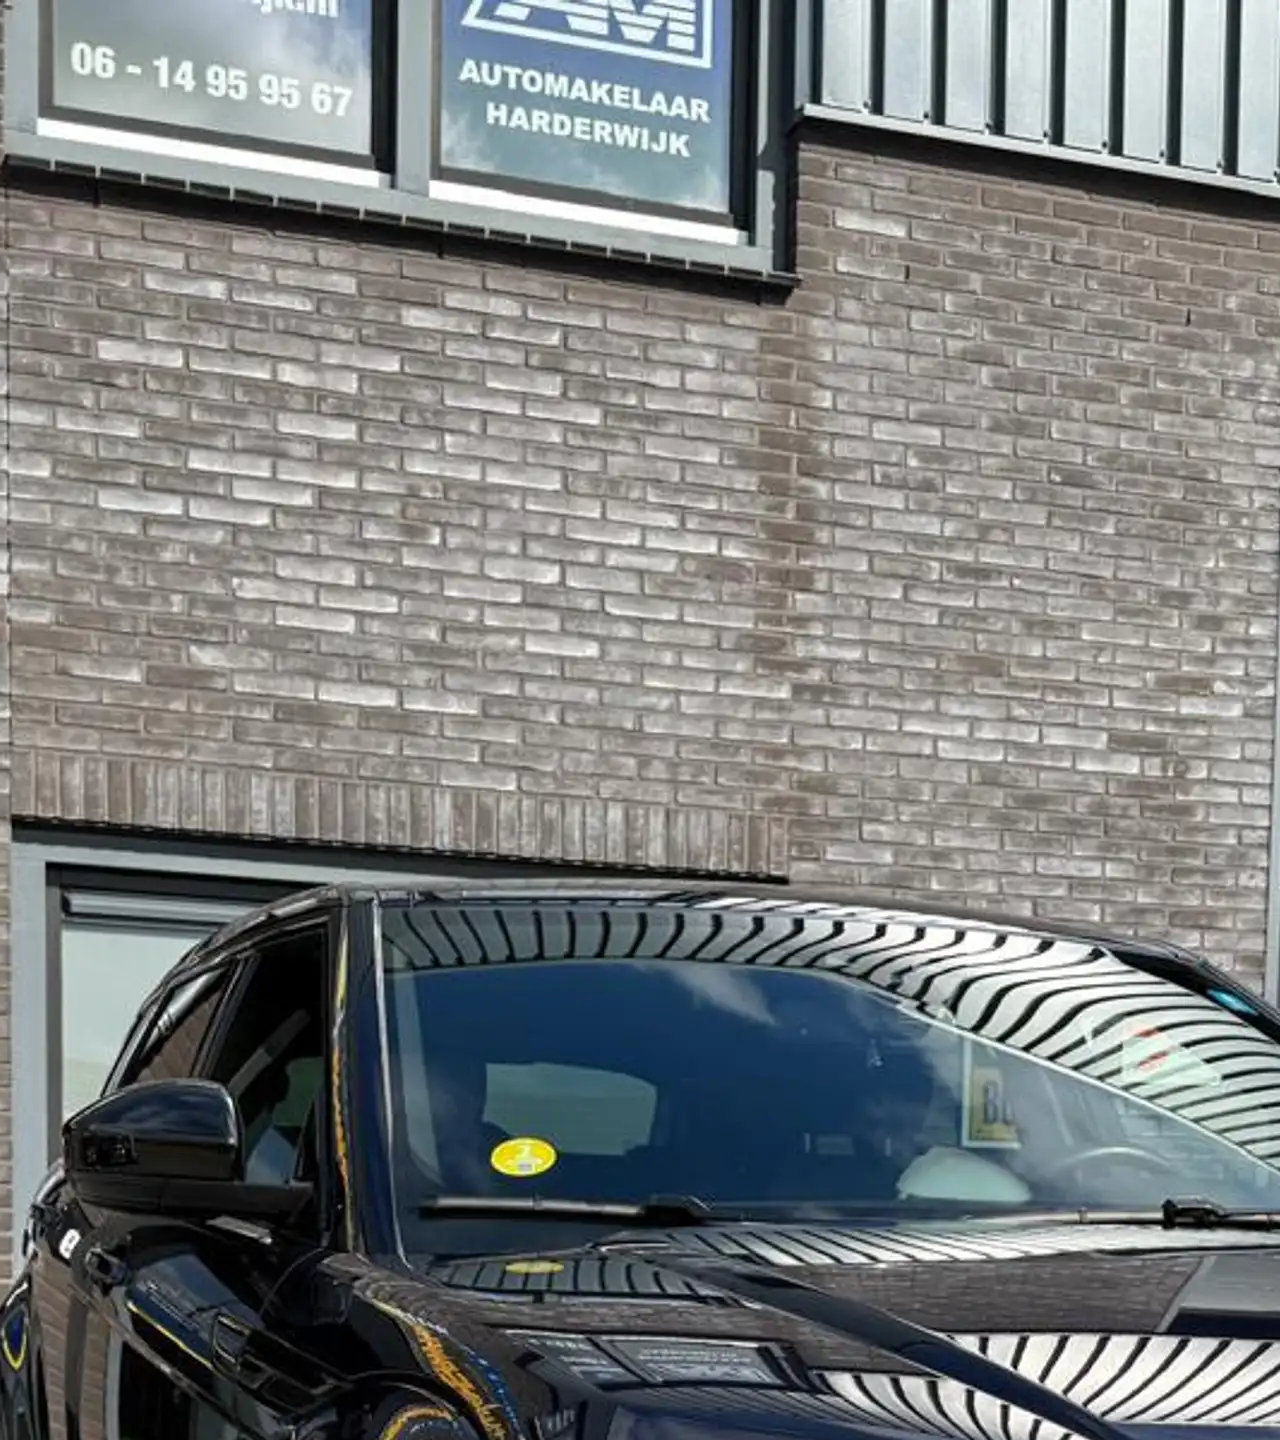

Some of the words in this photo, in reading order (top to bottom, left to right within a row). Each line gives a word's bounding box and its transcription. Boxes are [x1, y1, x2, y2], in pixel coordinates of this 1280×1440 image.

[71, 42, 116, 78] 06
[153, 56, 195, 92] 14
[206, 65, 248, 100] 95
[259, 74, 301, 109] 95
[311, 82, 352, 117] 67
[459, 58, 711, 123] AUTOMAKELAAR
[486, 102, 690, 158] HARDERWIJK
